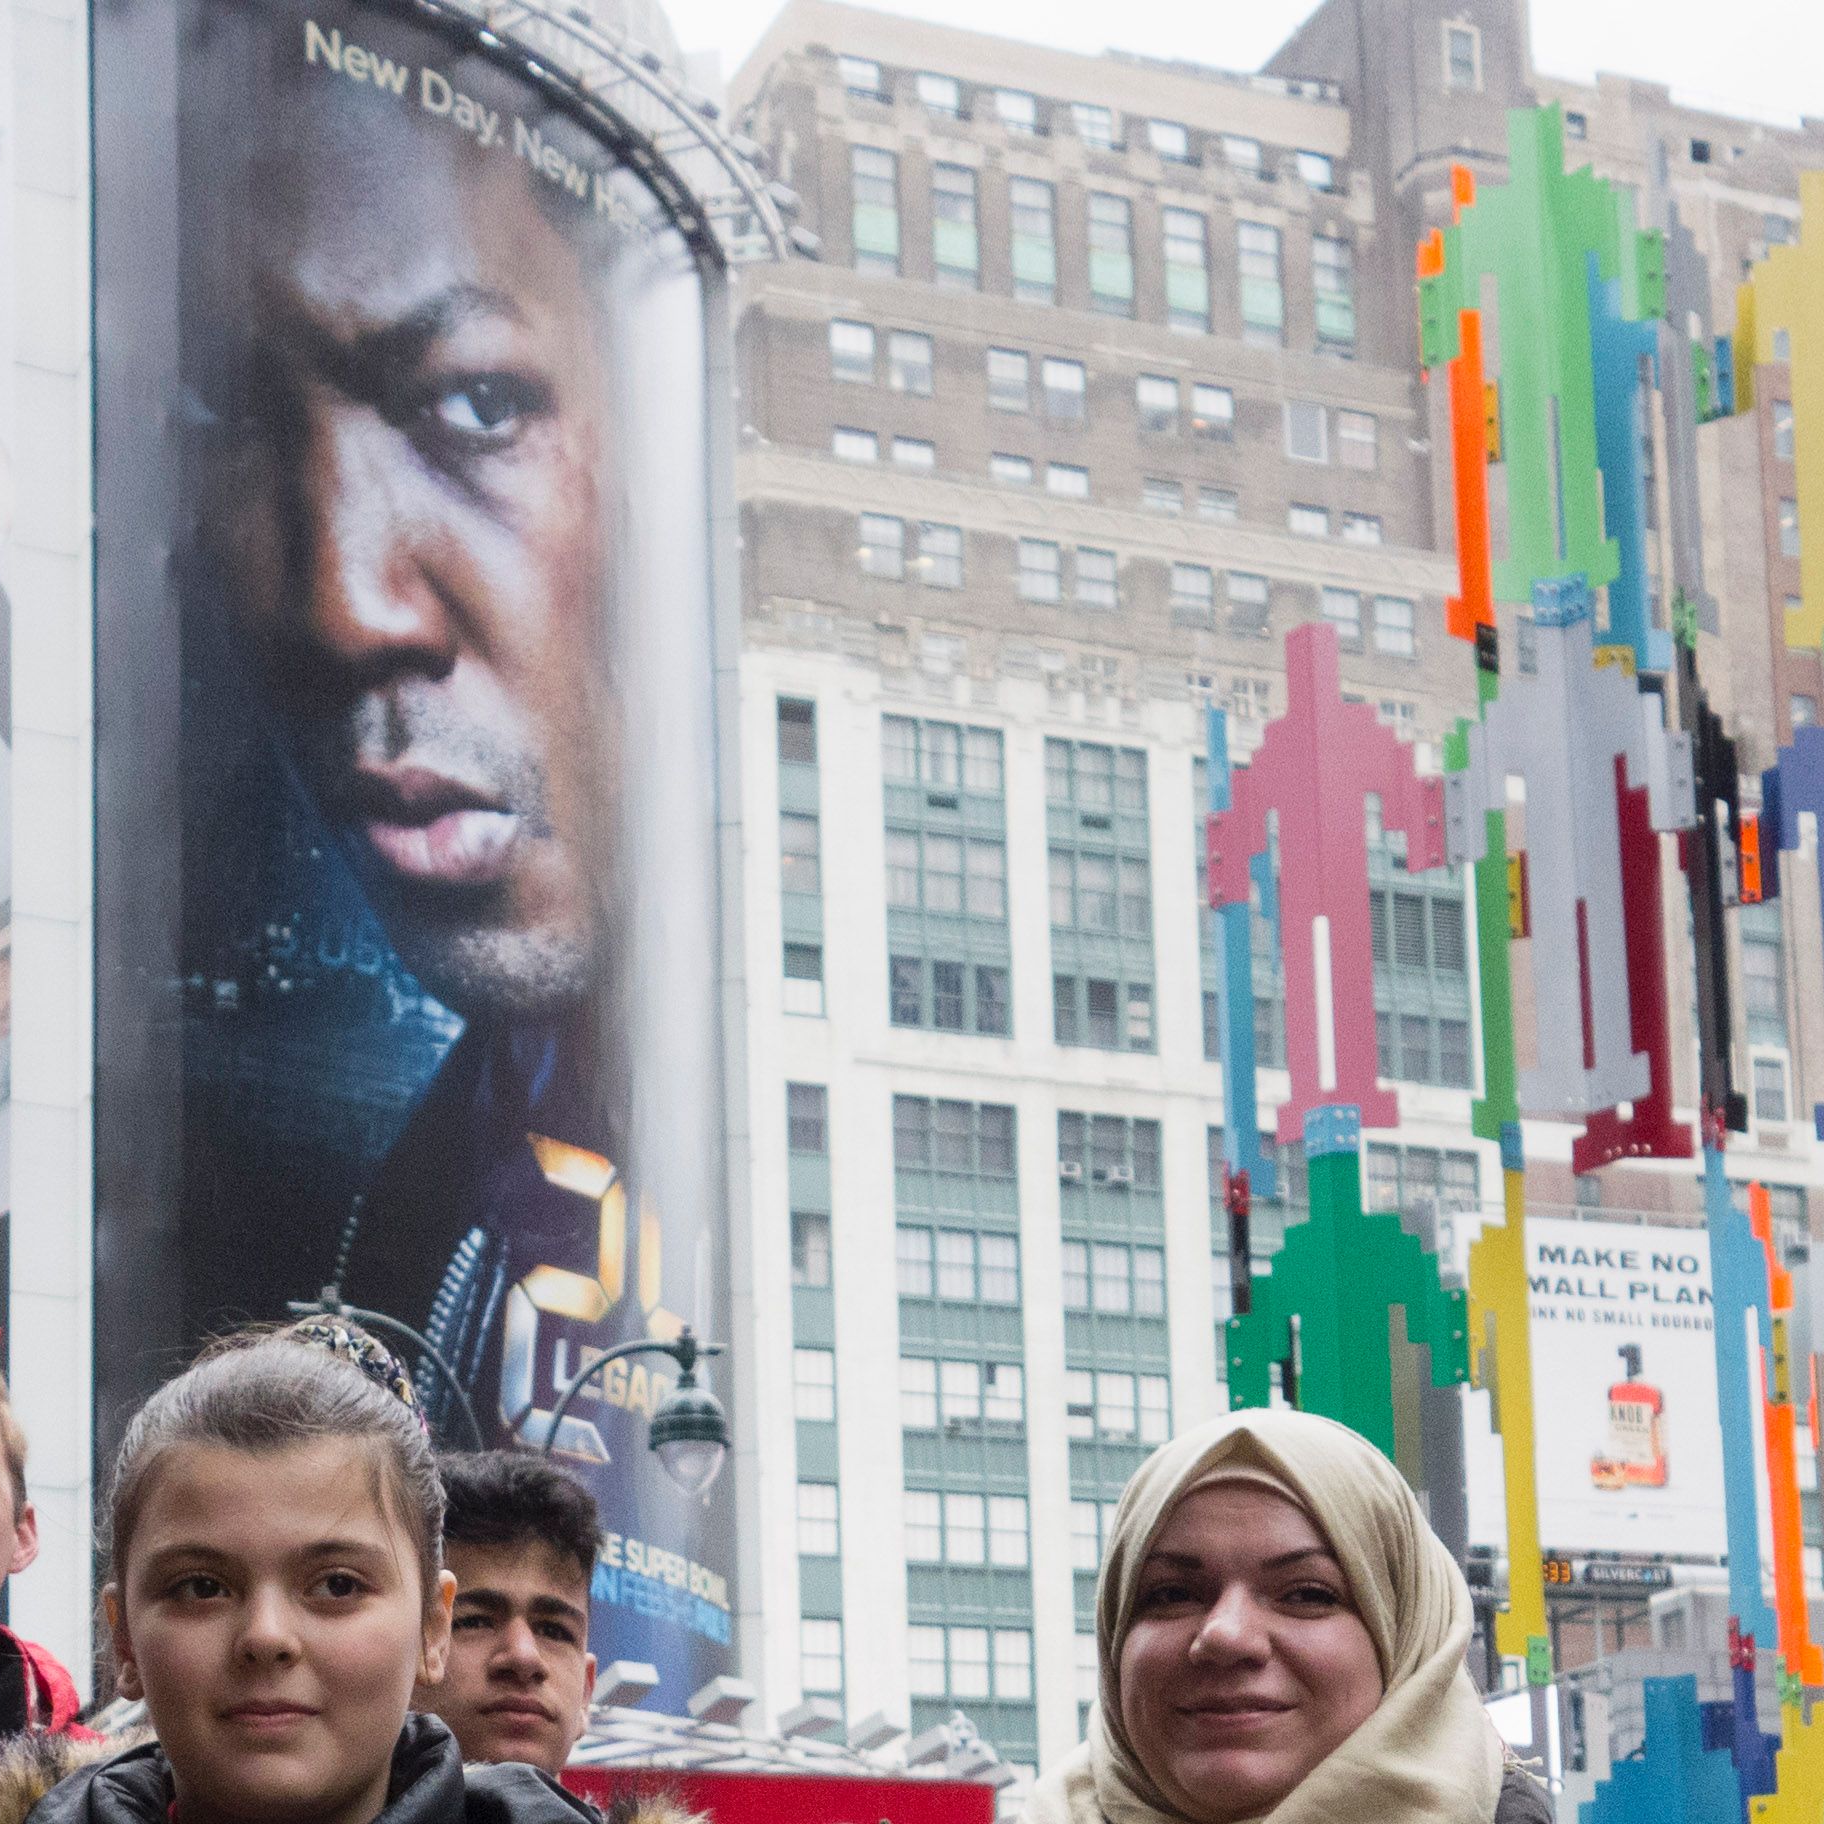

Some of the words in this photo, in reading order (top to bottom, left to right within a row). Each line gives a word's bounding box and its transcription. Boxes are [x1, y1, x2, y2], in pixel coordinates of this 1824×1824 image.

[304, 19, 409, 96] New
[420, 65, 505, 147] Day.
[513, 117, 589, 199] New
[1538, 1244, 1641, 1270] MAKE
[1650, 1252, 1700, 1274] NO
[1565, 1307, 1586, 1322] NO
[1592, 1309, 1644, 1327] SMALL
[626, 1538, 689, 1590] SUPER
